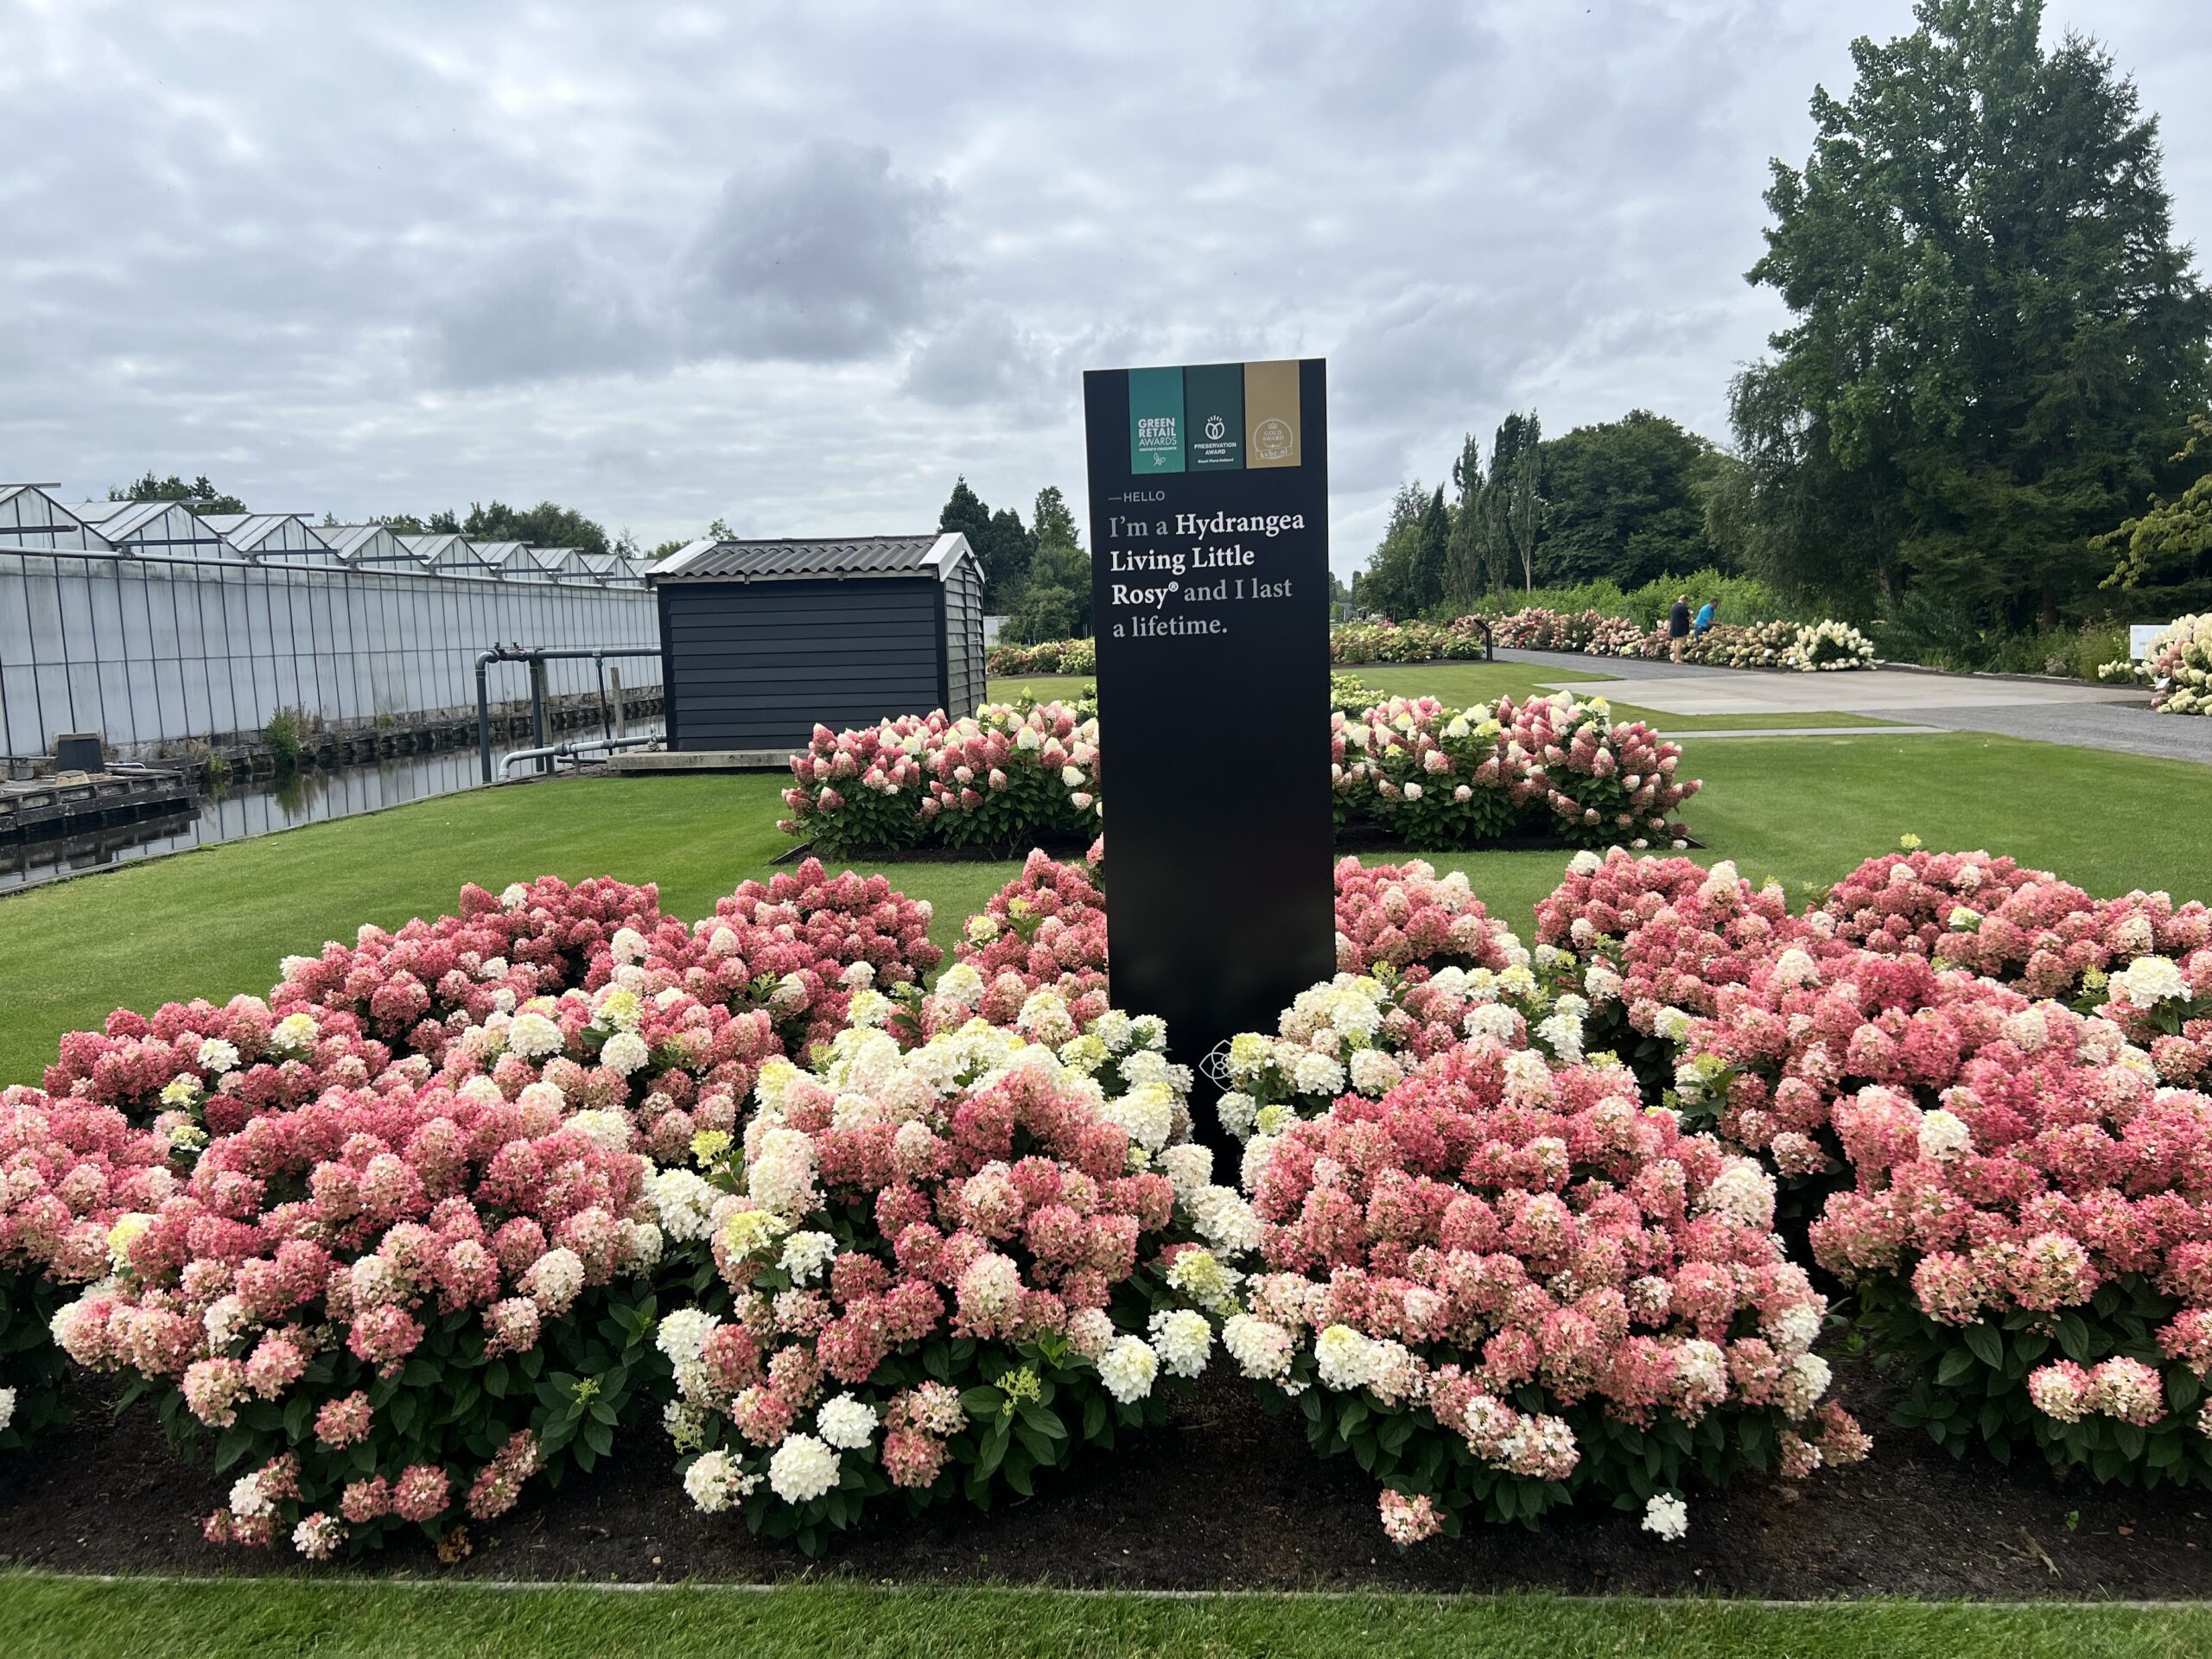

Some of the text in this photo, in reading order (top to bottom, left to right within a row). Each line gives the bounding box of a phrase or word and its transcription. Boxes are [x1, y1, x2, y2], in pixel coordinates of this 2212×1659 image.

[1138, 417, 1175, 429] GREEN
[1138, 427, 1177, 438] RETAIL
[1139, 436, 1177, 447] AWARDS
[1109, 511, 1306, 541] I'm a Hydrangea
[1110, 544, 1255, 575] Living Little
[1184, 578, 1228, 602] and
[1234, 579, 1244, 601] I
[1251, 578, 1293, 599] last
[1112, 615, 1228, 639] a lifetime.
